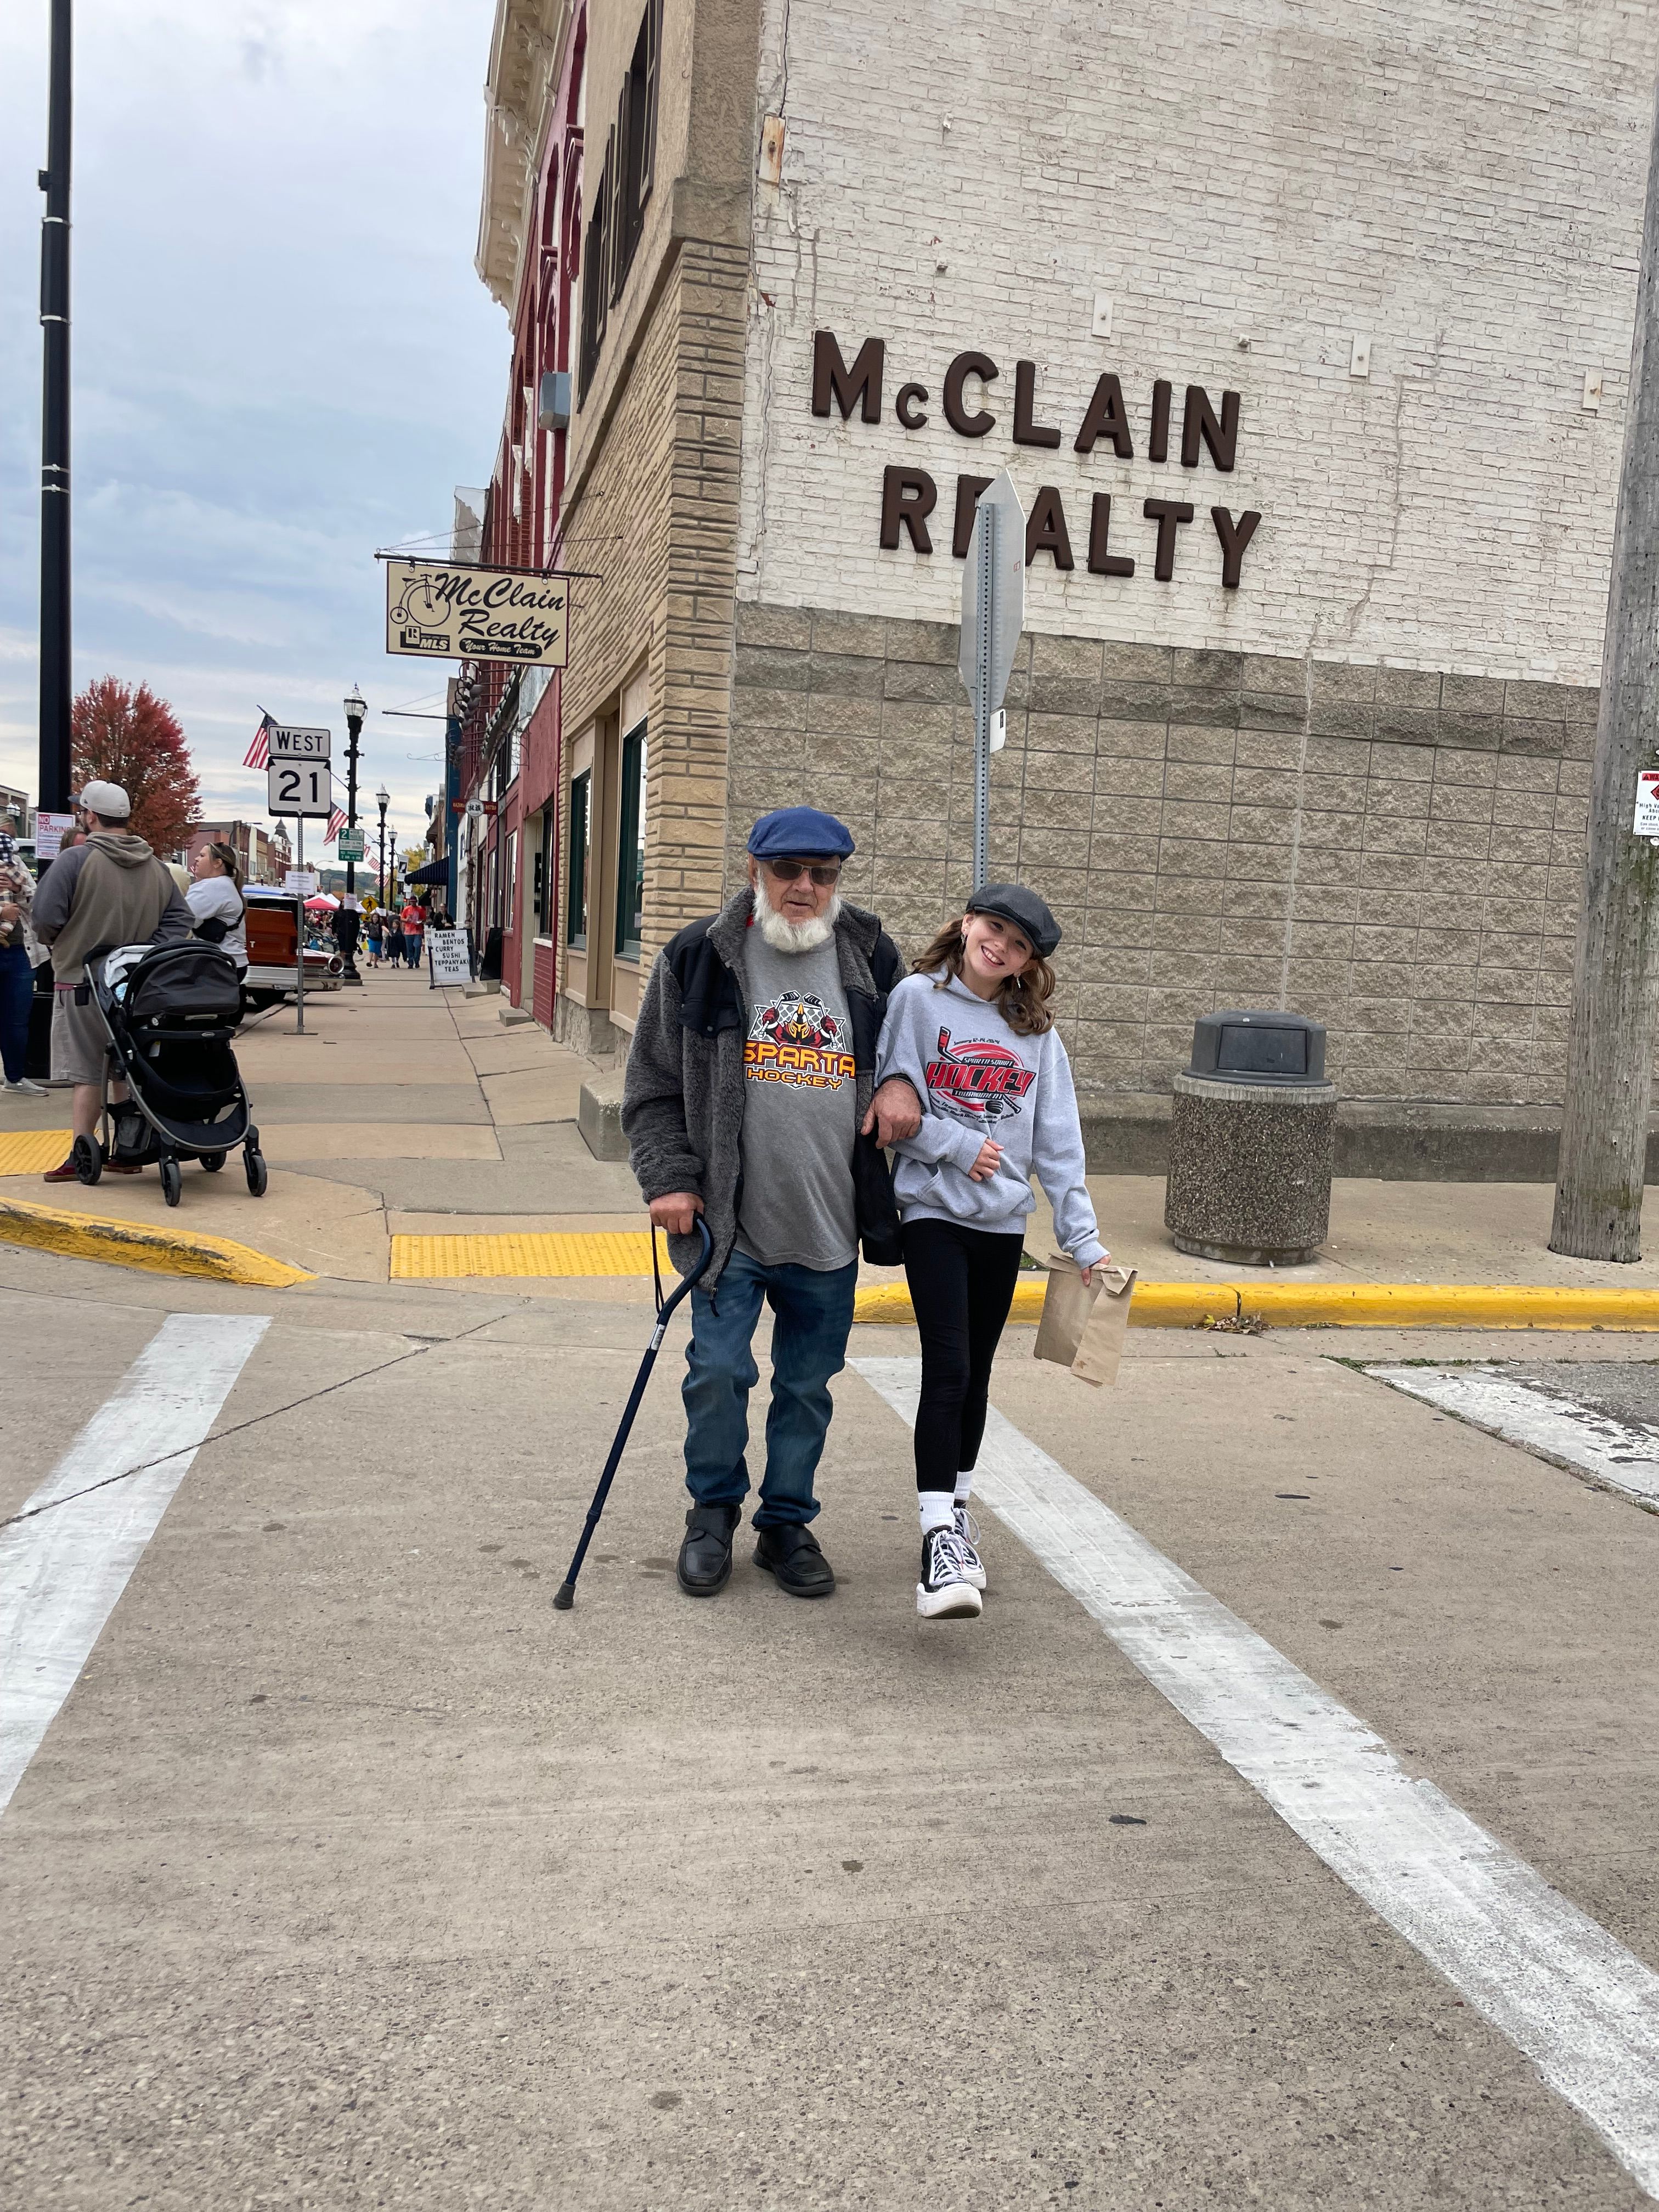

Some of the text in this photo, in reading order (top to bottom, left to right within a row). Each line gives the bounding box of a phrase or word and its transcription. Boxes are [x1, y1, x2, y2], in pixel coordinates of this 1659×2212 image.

[812, 330, 1240, 472] McCLAIN
[435, 573, 566, 611] McClain
[458, 608, 561, 650] Realty
[420, 639, 448, 650] MLS
[488, 642, 511, 653] Home
[276, 731, 323, 752] WEST
[279, 770, 318, 803] 21
[341, 830, 347, 839] 2
[743, 1041, 856, 1077] SPARTA
[747, 1068, 843, 1090] HOCKEY
[926, 1063, 1035, 1096] HOCKEY
[955, 1091, 1003, 1099] TOURNAMENT
